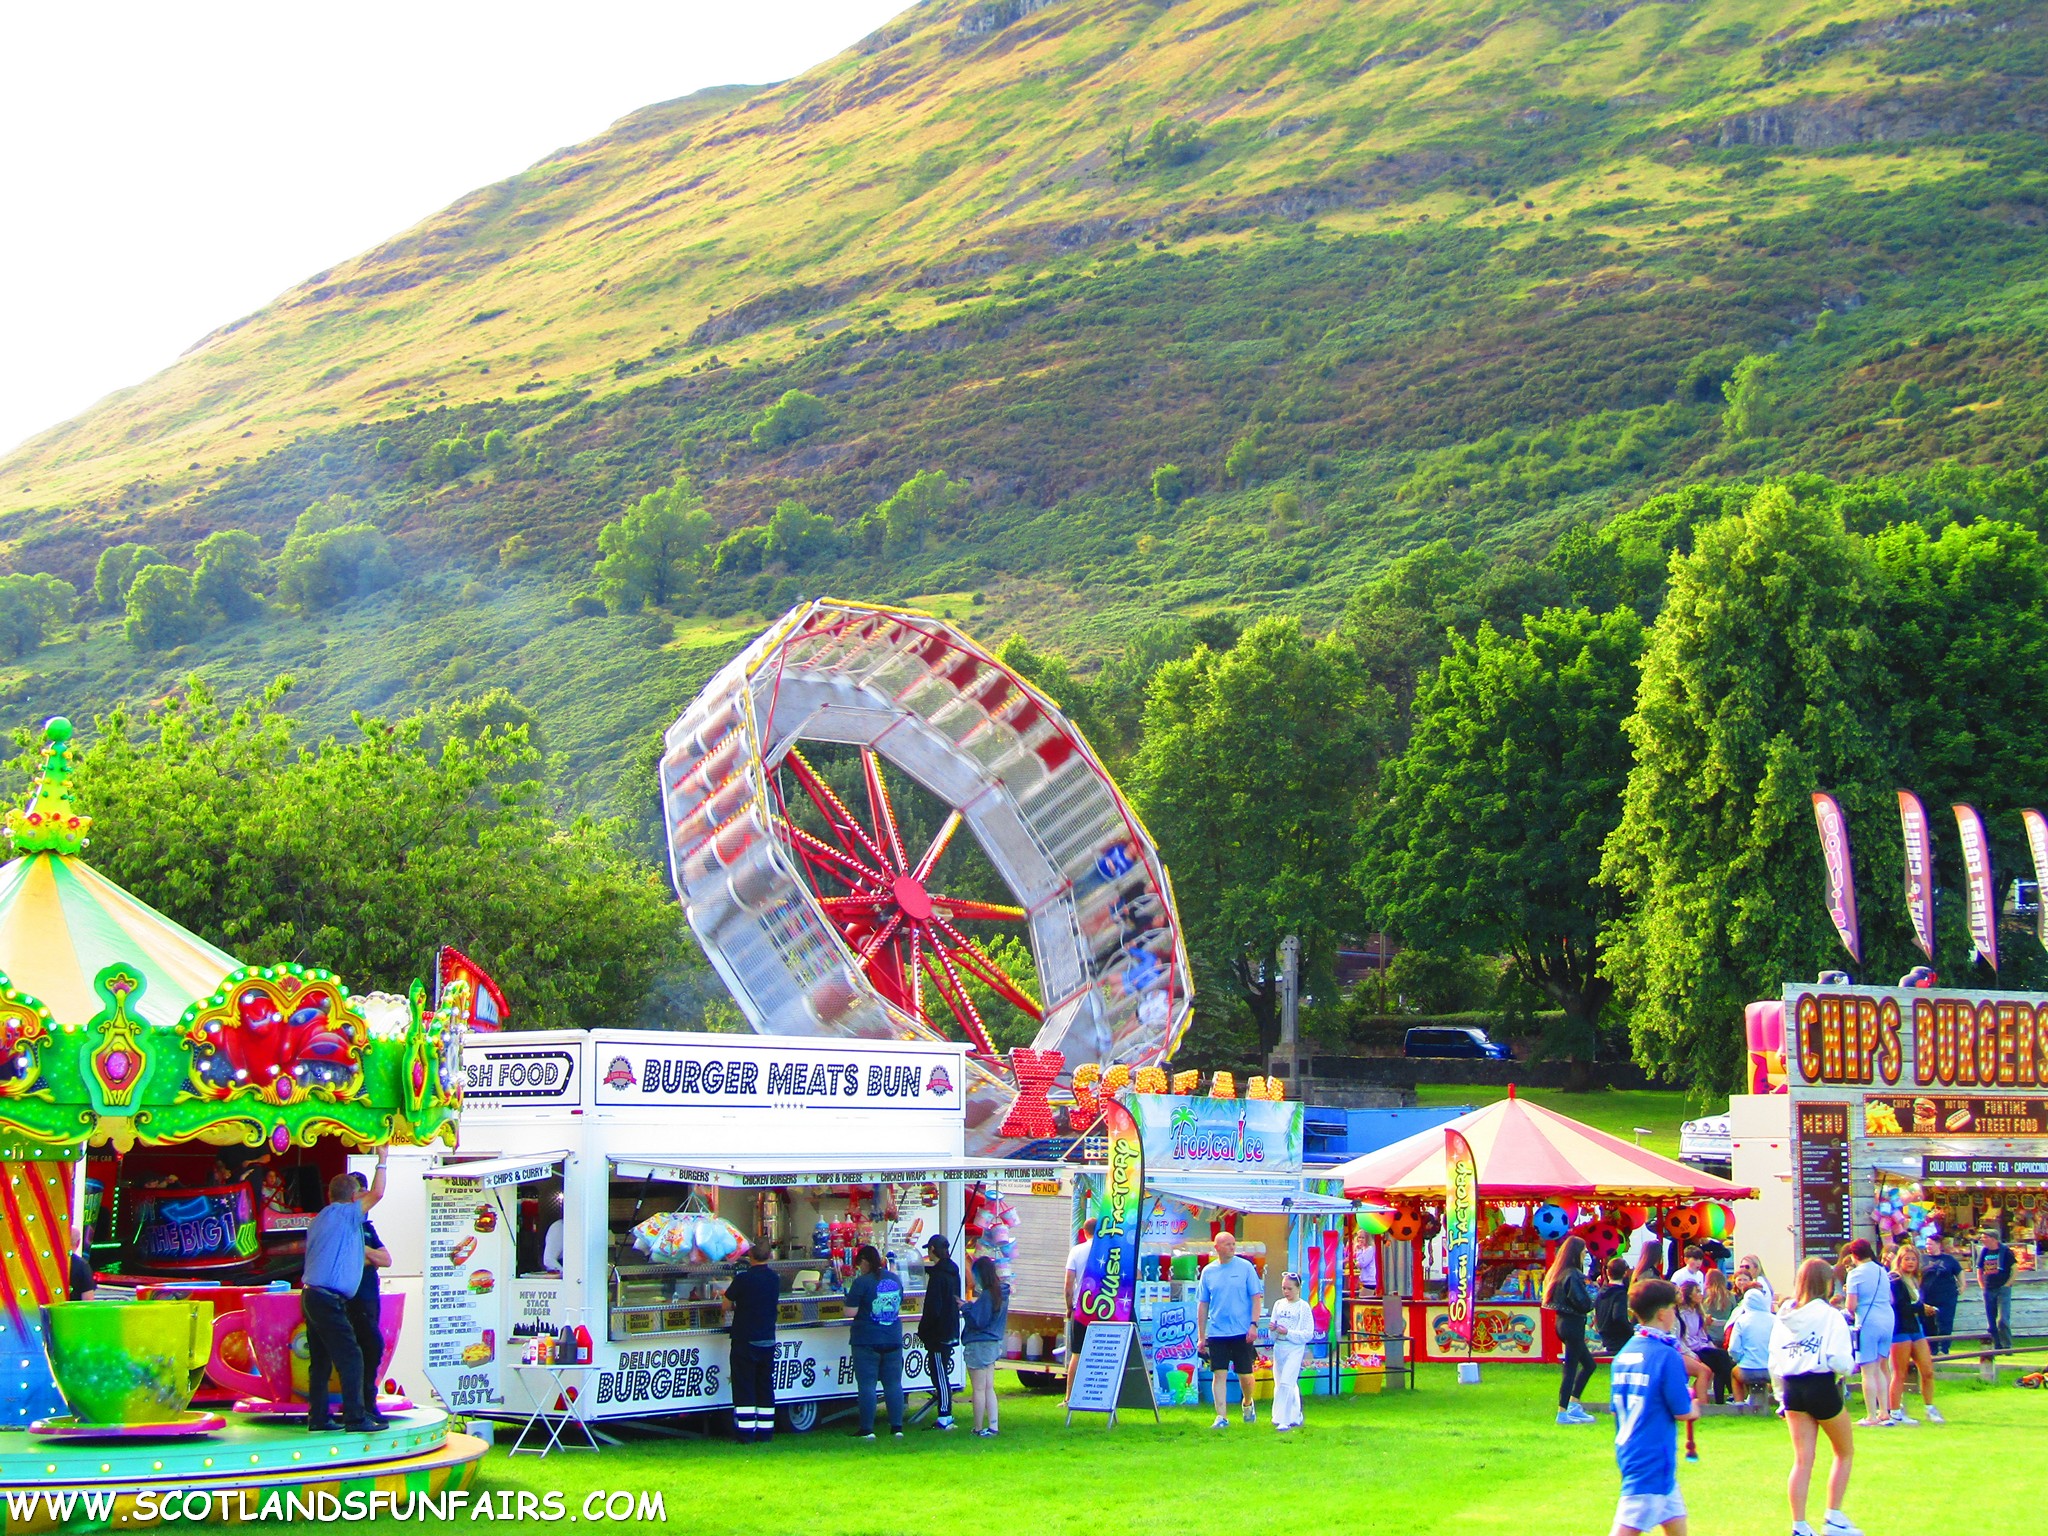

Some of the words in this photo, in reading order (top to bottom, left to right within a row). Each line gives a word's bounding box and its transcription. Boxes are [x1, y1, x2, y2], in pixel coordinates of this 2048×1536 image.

[1795, 992, 1902, 1086] CHIPS
[463, 1063, 493, 1088] SH
[499, 1062, 559, 1087] FOOD
[642, 1059, 759, 1095] BURGER
[767, 1062, 859, 1097] MEATS
[867, 1065, 922, 1098] BUN
[1893, 1100, 1911, 1109] CHIPS
[1984, 1101, 2027, 1115] FUNTIME
[1802, 1114, 1843, 1135] MENU
[1974, 1118, 2012, 1133] STREET
[2013, 1118, 2039, 1133] FOOD
[1004, 1168, 1031, 1179] FOOTLONG
[1031, 1167, 1055, 1178] SAUSAGE
[1929, 1161, 1945, 1172] COLD
[1945, 1161, 1967, 1172] DRINKS
[1972, 1161, 1993, 1173] COFFEE
[1997, 1162, 2010, 1173] TEA
[493, 1172, 514, 1186] CHIPS
[514, 1170, 521, 1181] &
[521, 1166, 544, 1180] CURRY
[678, 1168, 710, 1182] BURGERS
[742, 1174, 769, 1185] CHICKEN
[769, 1173, 797, 1184] BURGERS
[815, 1173, 834, 1184] CHIPS
[834, 1173, 841, 1183] &
[841, 1172, 863, 1183] CHEESE
[880, 1172, 905, 1182] CHICKEN
[905, 1171, 927, 1181] WRAPS
[943, 1170, 963, 1180] CHEESE
[963, 1169, 988, 1179] BURGERS
[181, 1216, 222, 1253] BIG
[519, 1291, 536, 1300] NEW
[538, 1291, 557, 1300] YORK
[526, 1299, 549, 1308] STACK
[523, 1307, 551, 1316] BURGER
[1160, 1306, 1185, 1326] ICE
[1156, 1321, 1196, 1342] COLD
[1155, 1336, 1197, 1363] SLUSH
[618, 1347, 700, 1371] DELICIOUS
[458, 1373, 490, 1391] 100%
[596, 1364, 720, 1404] BURGERS
[450, 1387, 495, 1406] TASTY
